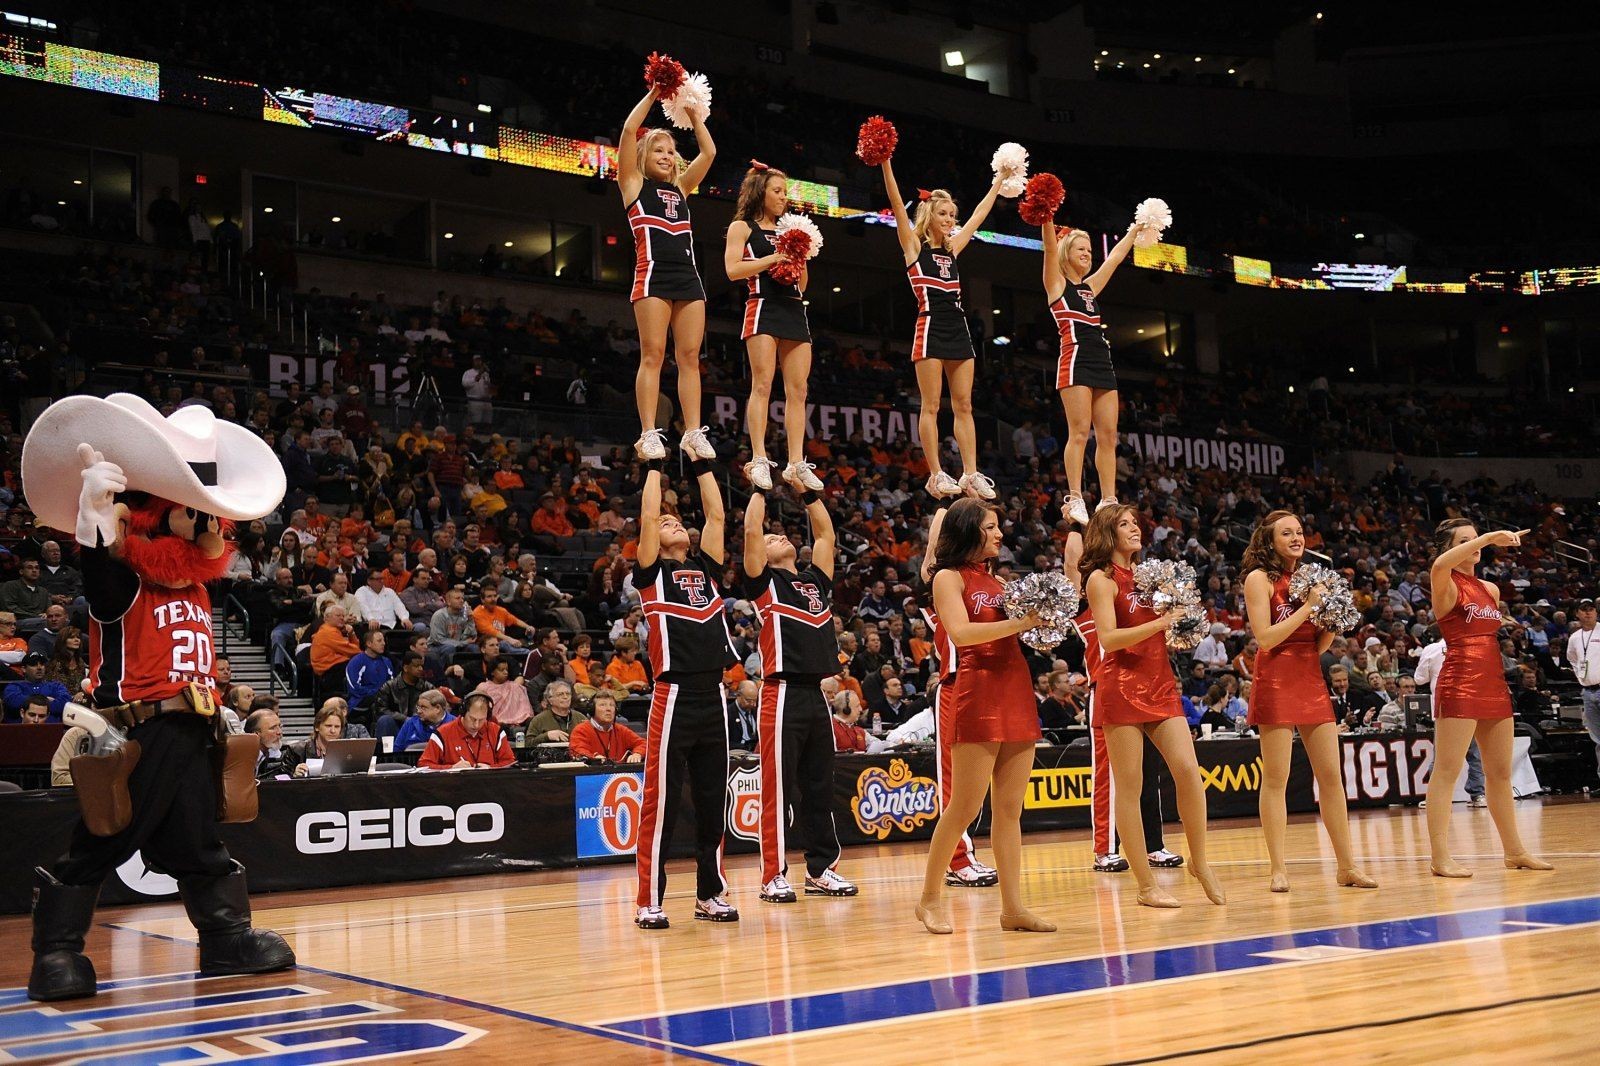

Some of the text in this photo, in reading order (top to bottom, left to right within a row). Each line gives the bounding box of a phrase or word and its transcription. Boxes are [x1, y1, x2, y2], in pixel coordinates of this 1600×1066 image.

[757, 47, 783, 63] 310
[1049, 110, 1073, 122] 311
[714, 395, 922, 446] BSKETBAL
[1117, 432, 1284, 476] AMPIONSHIP
[1555, 463, 1583, 480] 108
[171, 629, 213, 675] 20
[738, 779, 760, 792] PHIL
[1313, 738, 1433, 803] IG12
[579, 776, 646, 851] MOTEL 6
[741, 798, 760, 827] 6
[860, 783, 935, 819] Sunkist
[295, 802, 505, 855] GEICO
